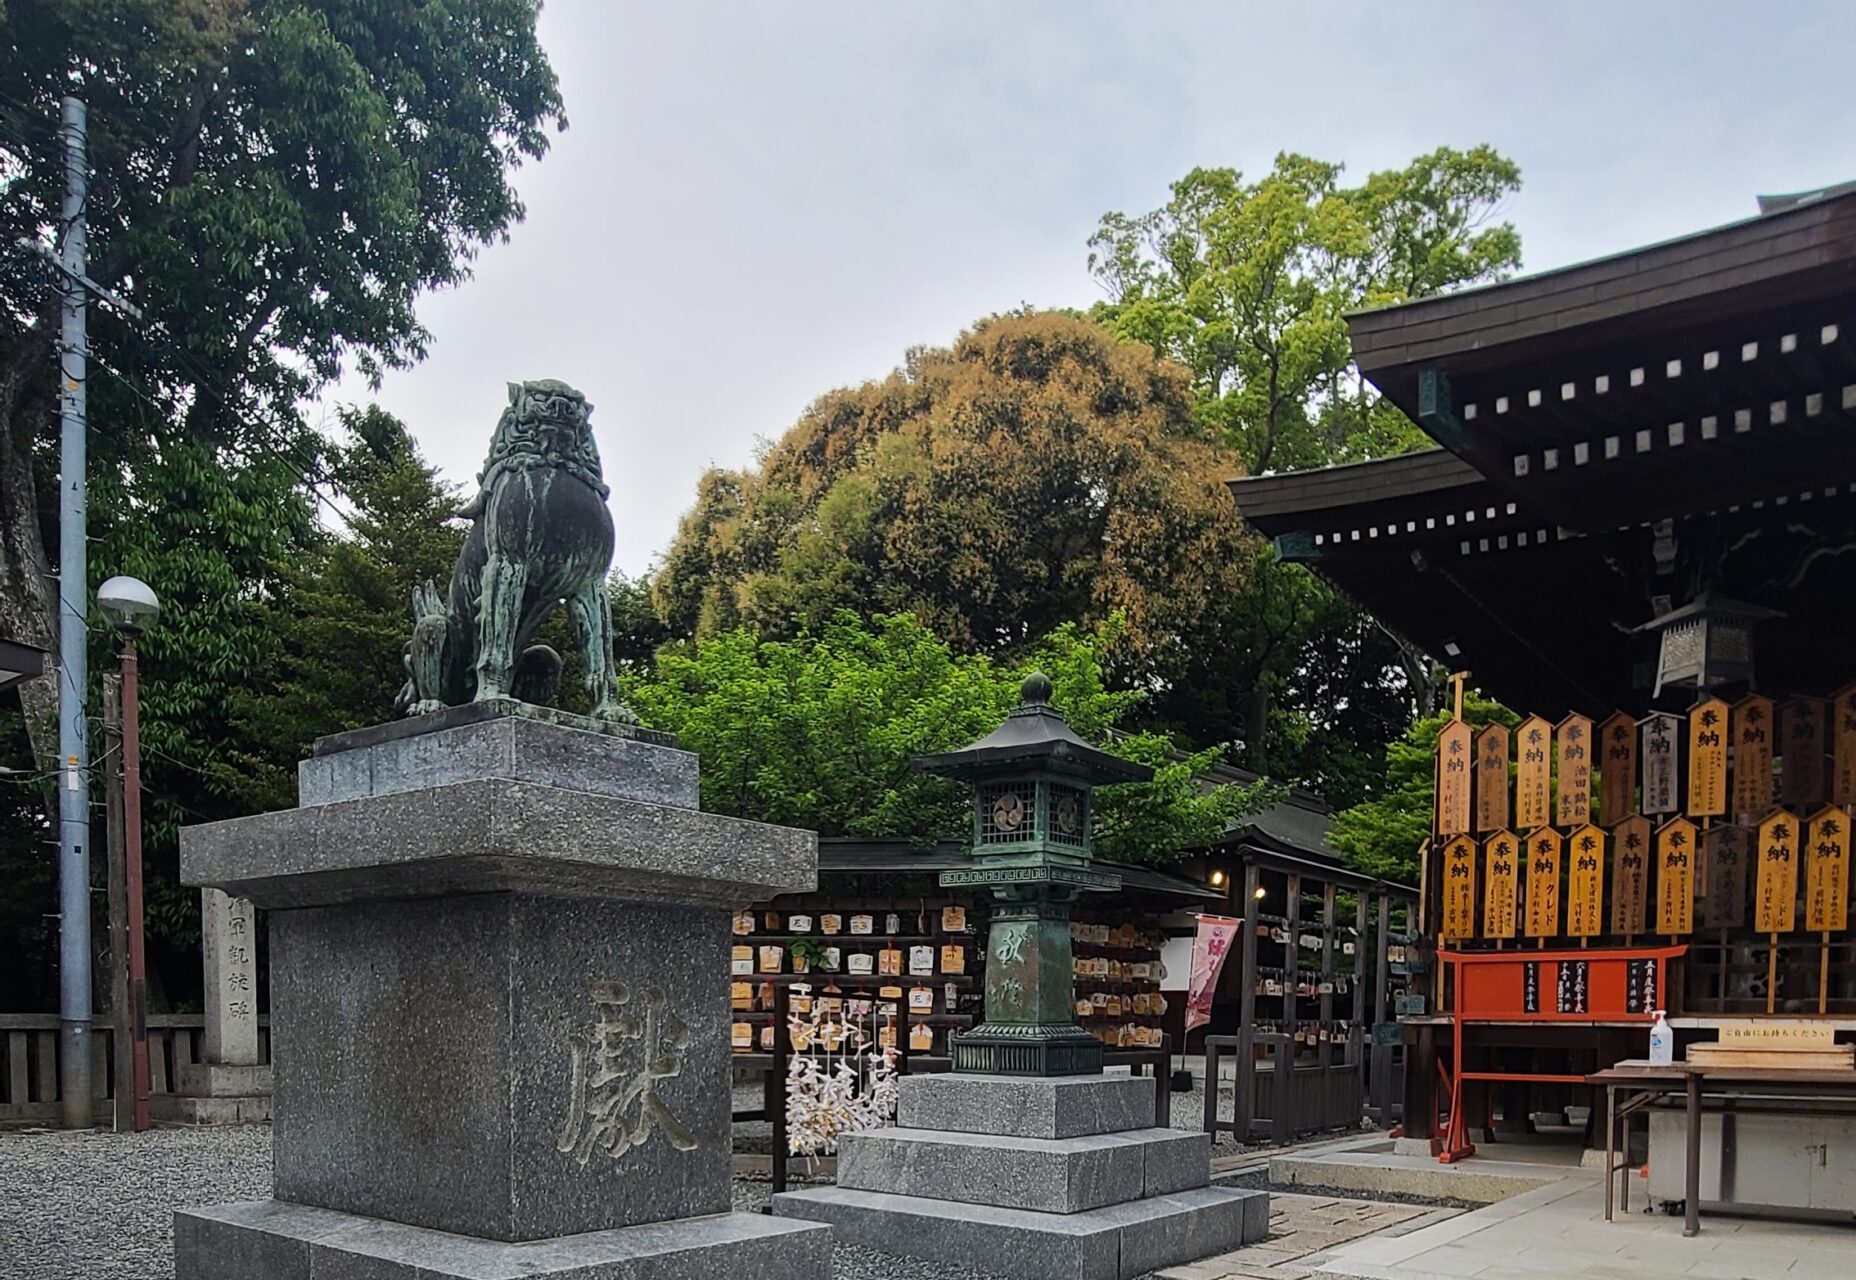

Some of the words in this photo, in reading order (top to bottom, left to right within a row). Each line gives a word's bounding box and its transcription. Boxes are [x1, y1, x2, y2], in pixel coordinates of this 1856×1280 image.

[1564, 725, 1584, 761] 奉納
[1609, 724, 1630, 761] 奉納
[1650, 717, 1671, 755] 奉納
[1697, 710, 1720, 748] 奉納
[1743, 706, 1765, 745] 奉納
[1447, 739, 1464, 773] 奉納
[1484, 735, 1501, 770] 奉納
[1525, 729, 1544, 763] 奉納
[1535, 838, 1554, 875] 奉納
[1577, 835, 1597, 872] 奉納
[1622, 833, 1642, 870] 奉納
[1666, 831, 1688, 868] 奉納
[1767, 823, 1791, 862] 奉納
[1817, 819, 1841, 859] 奉納
[1451, 844, 1469, 879] 奉納
[1493, 841, 1512, 877] 奉納
[1546, 883, 1555, 926] クレド
[1726, 1029, 1830, 1038] ご自由にお持ちください
